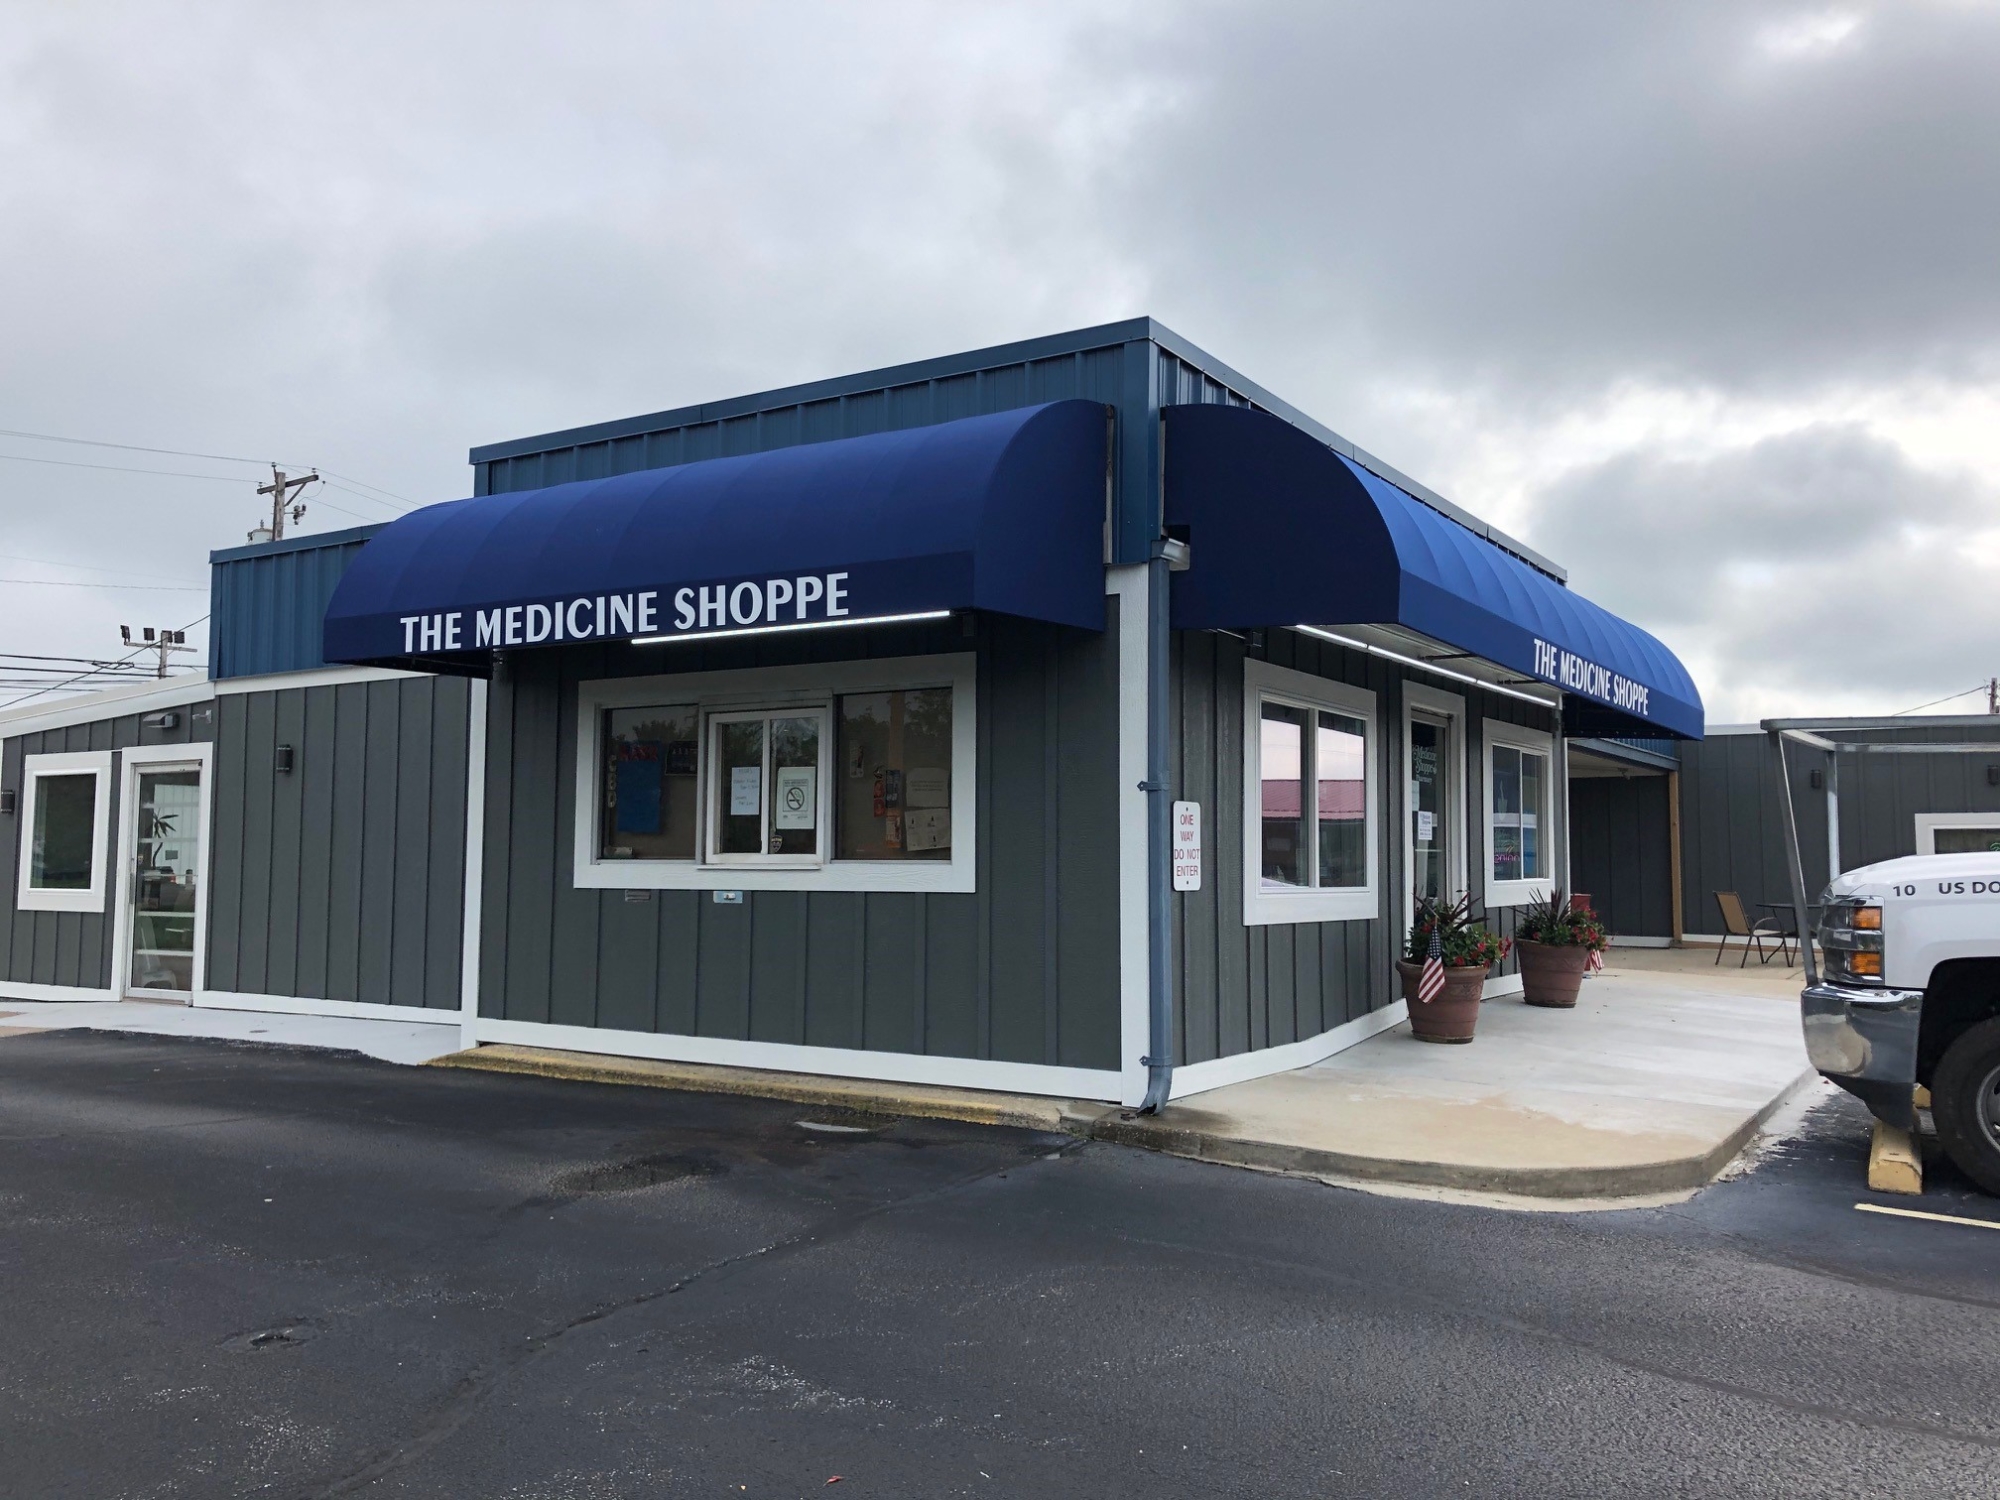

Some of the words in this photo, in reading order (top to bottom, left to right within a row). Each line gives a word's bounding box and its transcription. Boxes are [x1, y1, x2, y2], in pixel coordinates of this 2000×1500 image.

[400, 612, 462, 653] THE
[475, 591, 658, 647] MEDICINE
[673, 572, 849, 630] SHOPPE
[1533, 638, 1557, 681] THE
[1559, 650, 1612, 701] MEDICINE
[1613, 674, 1649, 716] SHOPPE
[1180, 814, 1194, 825] ONE
[1180, 831, 1194, 842] WAY
[1174, 849, 1184, 860] DO
[1186, 849, 1200, 860] NOT
[1176, 865, 1199, 877] ENTER
[1892, 884, 1916, 897] 10
[1938, 882, 1965, 894] US
[1972, 881, 2000, 894] DO
